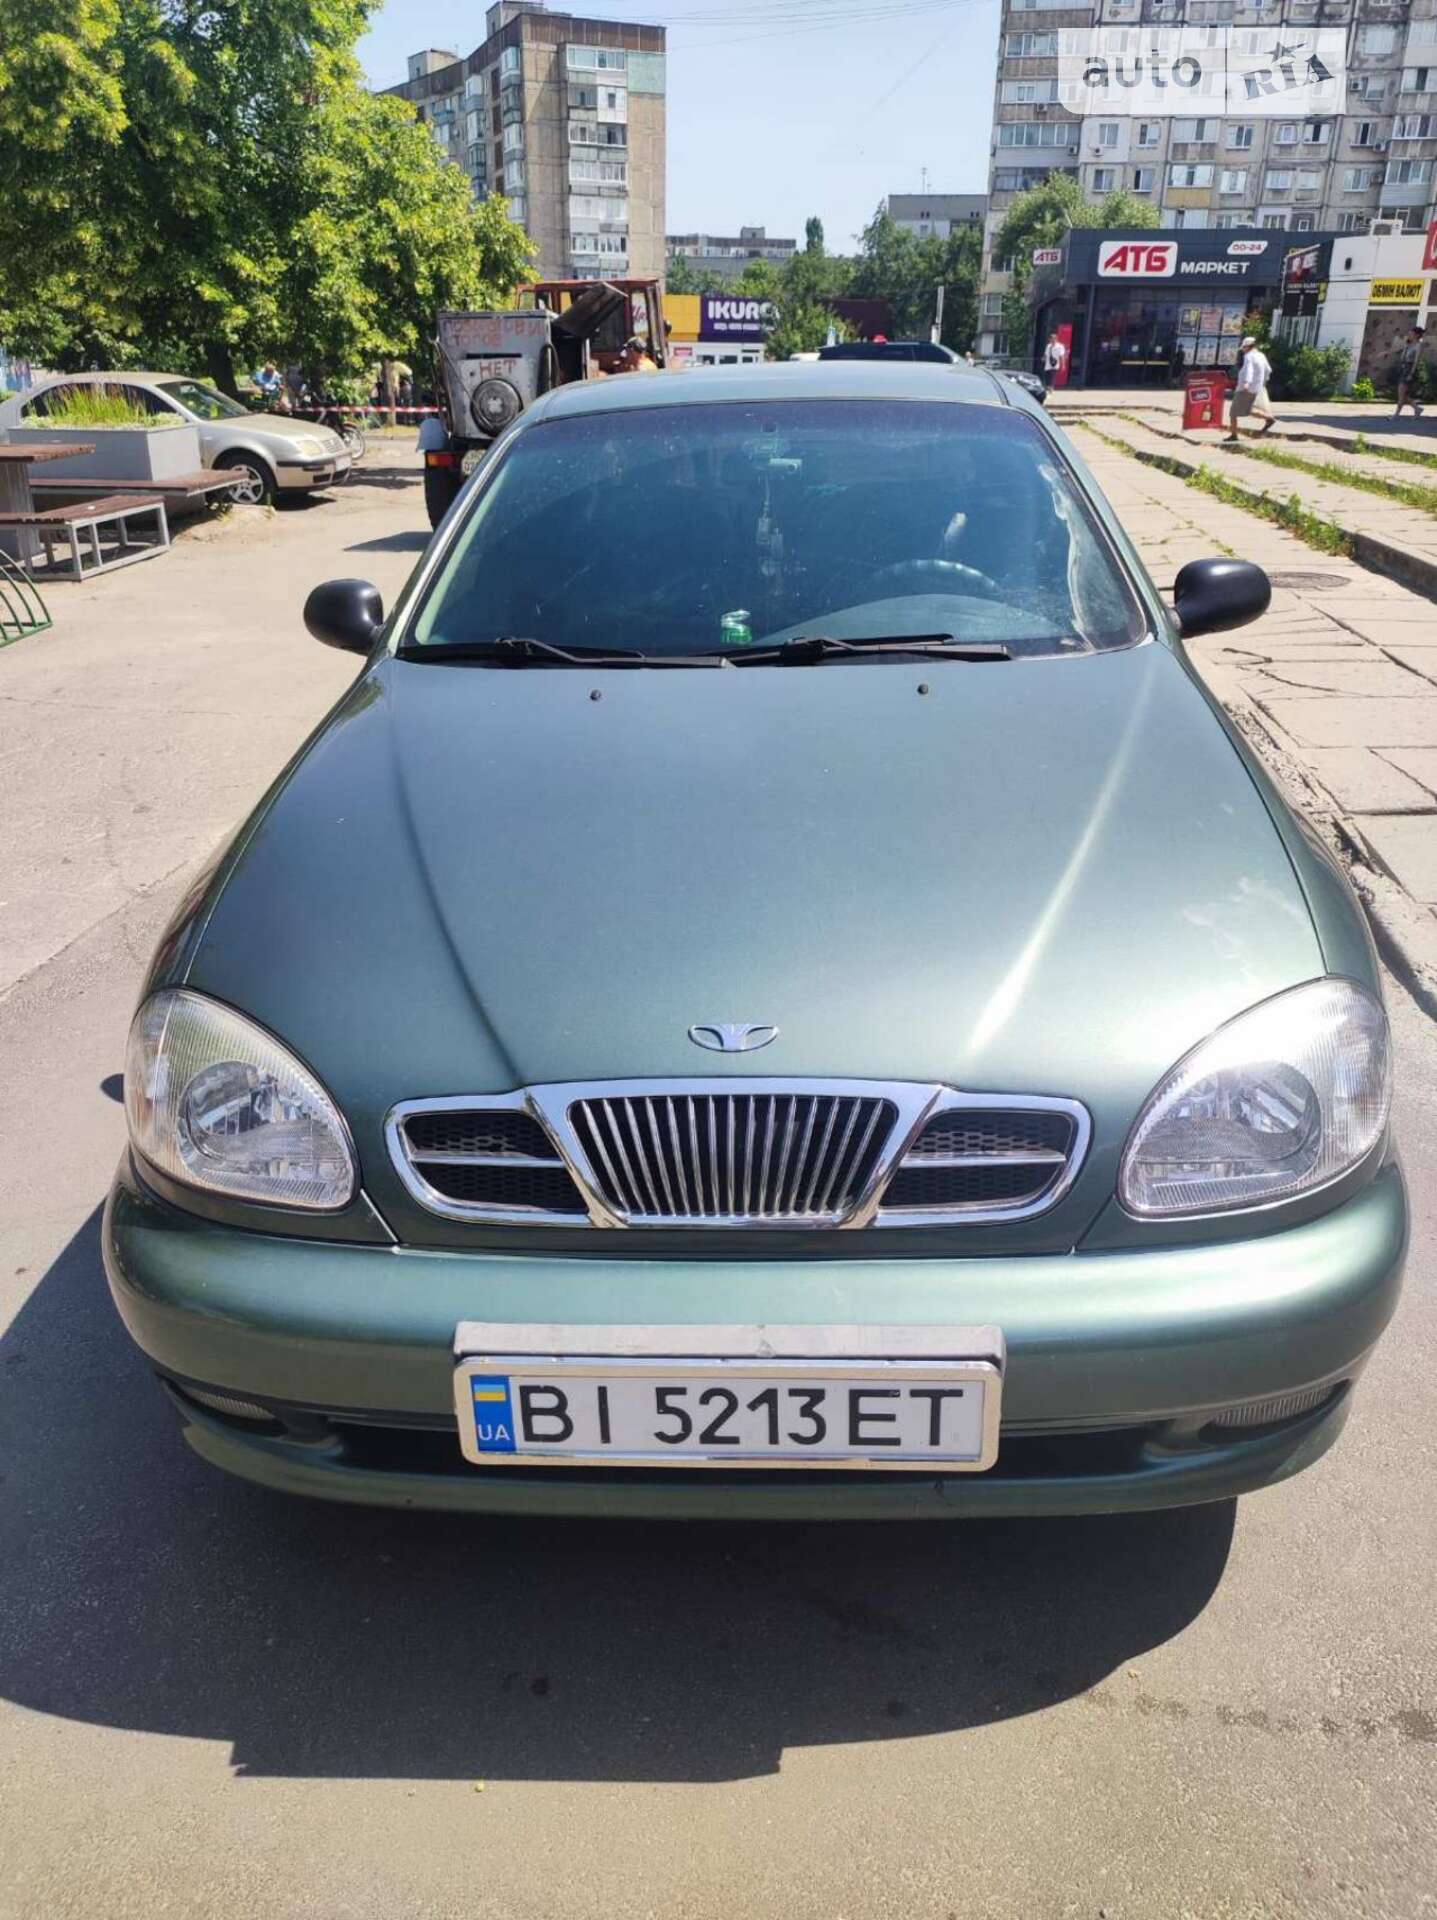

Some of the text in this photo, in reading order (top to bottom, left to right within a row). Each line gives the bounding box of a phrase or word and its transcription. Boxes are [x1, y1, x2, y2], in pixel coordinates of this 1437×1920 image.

[1034, 250, 1059, 262] АТБ
[1103, 245, 1173, 272] АТБ
[1180, 261, 1250, 274] МАРКЕТ
[518, 1383, 965, 1447] BI 5213 ET
[477, 1423, 511, 1442] UA
